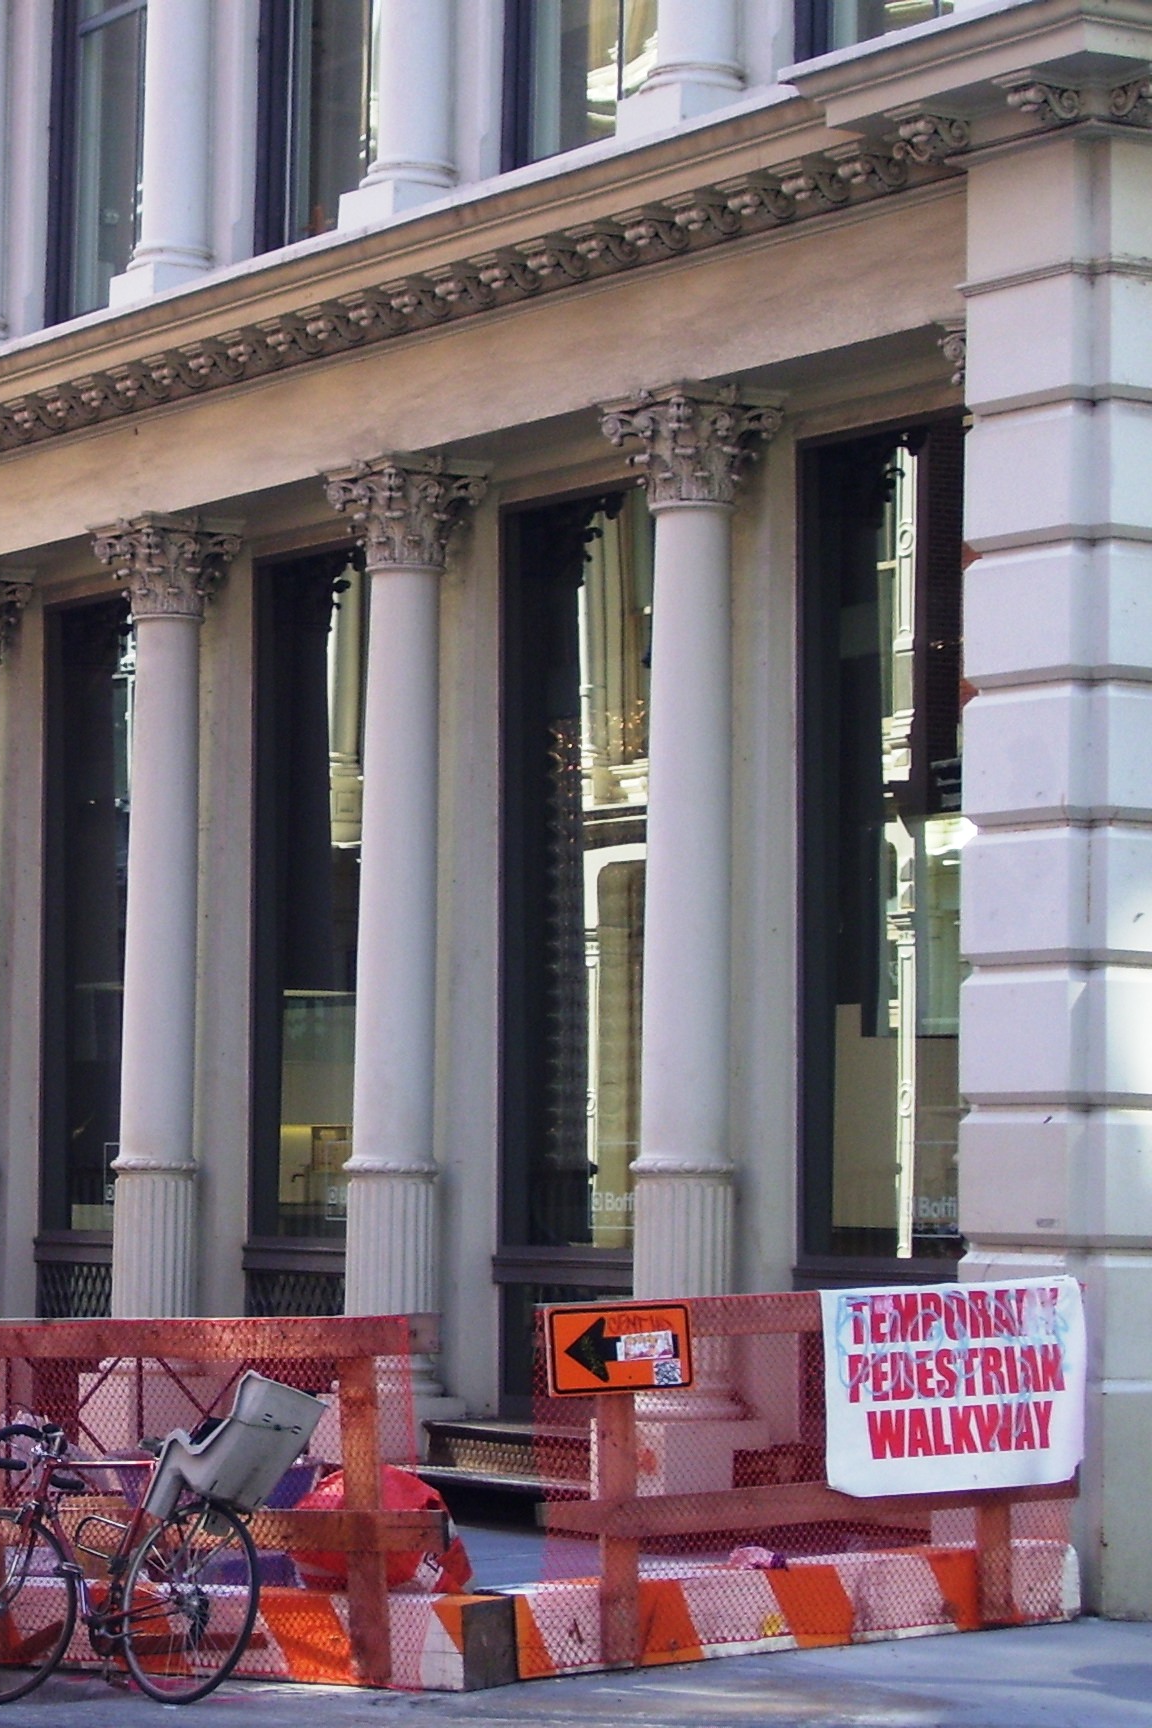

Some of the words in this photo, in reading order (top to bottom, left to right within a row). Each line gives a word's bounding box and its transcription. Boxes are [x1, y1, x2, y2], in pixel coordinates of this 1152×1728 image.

[605, 1192, 635, 1212] Boff
[848, 1344, 1065, 1404] PEDESTRIAN
[866, 1400, 1053, 1460] WALKWAY
